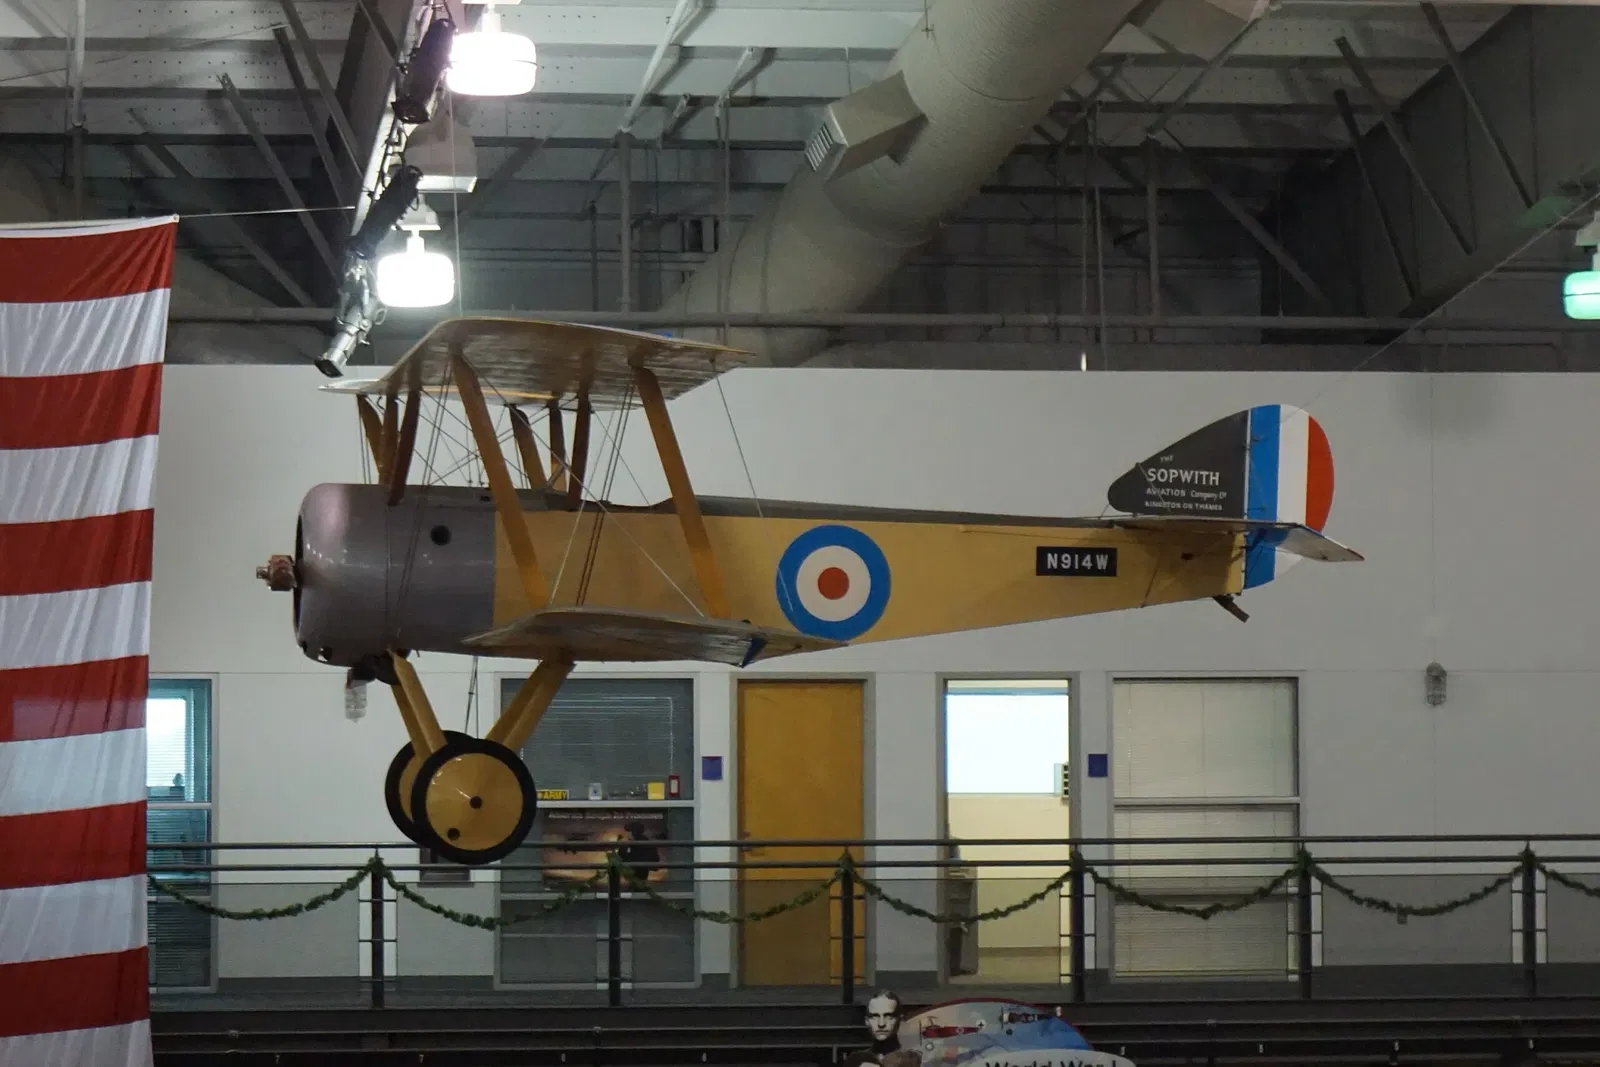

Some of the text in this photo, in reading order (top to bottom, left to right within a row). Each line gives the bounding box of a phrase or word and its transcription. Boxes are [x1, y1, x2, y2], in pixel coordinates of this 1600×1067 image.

[1147, 468, 1220, 486] SOPWITH
[1146, 488, 1186, 497] AVIATION
[1195, 503, 1222, 511] THAMES
[1046, 553, 1109, 570] N914W
[543, 791, 568, 800] ARMY
